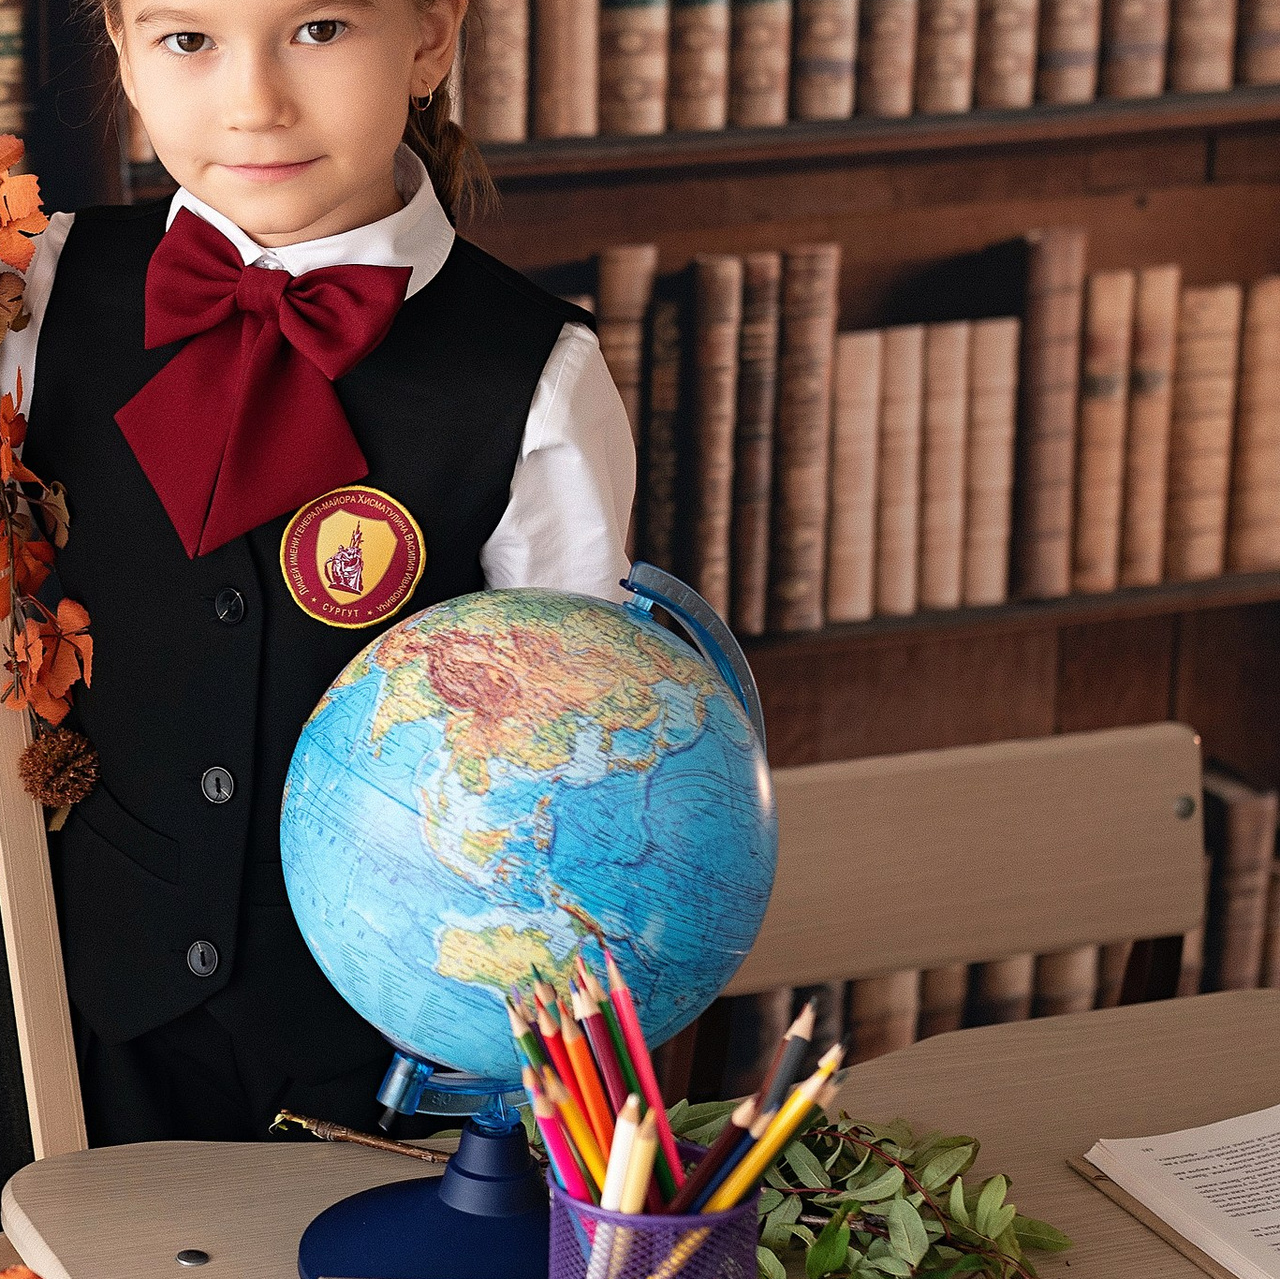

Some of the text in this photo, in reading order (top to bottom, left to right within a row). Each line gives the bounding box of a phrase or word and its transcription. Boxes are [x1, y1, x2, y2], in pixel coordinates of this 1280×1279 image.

[294, 495, 356, 537] ГЕНЕРАЛ-МАЙОРА
[289, 537, 300, 566] ИМЕНИ
[404, 533, 416, 571] ВАСИЛИЯ
[322, 603, 359, 617] СУРГУТ
[376, 572, 414, 612] ИВАНОВИЧА
